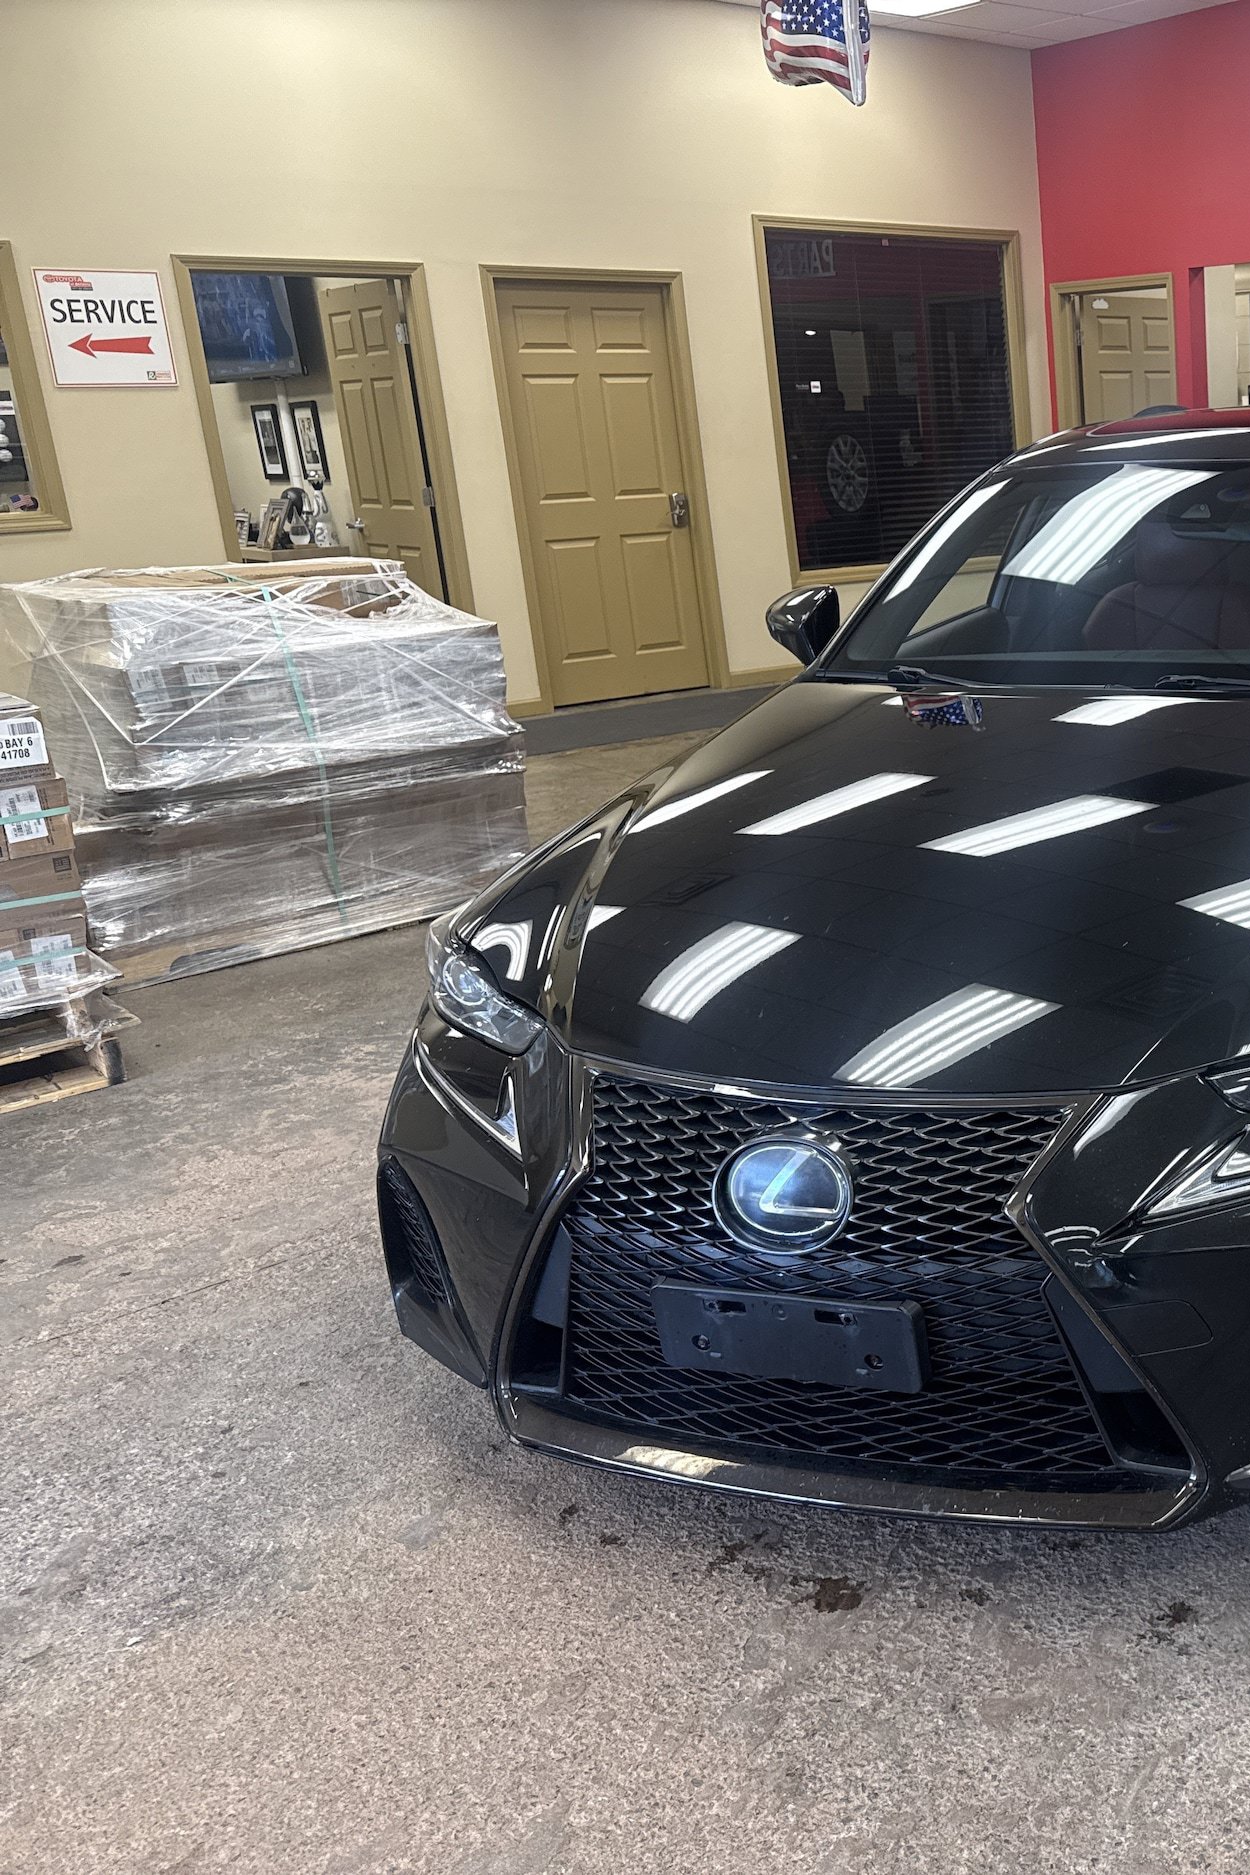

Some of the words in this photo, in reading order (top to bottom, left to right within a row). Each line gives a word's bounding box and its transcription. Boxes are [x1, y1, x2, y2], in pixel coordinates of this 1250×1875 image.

[50, 299, 157, 324] SERVICE
[5, 738, 23, 749] BAY
[27, 737, 33, 746] 6
[1, 748, 30, 760] 41708
